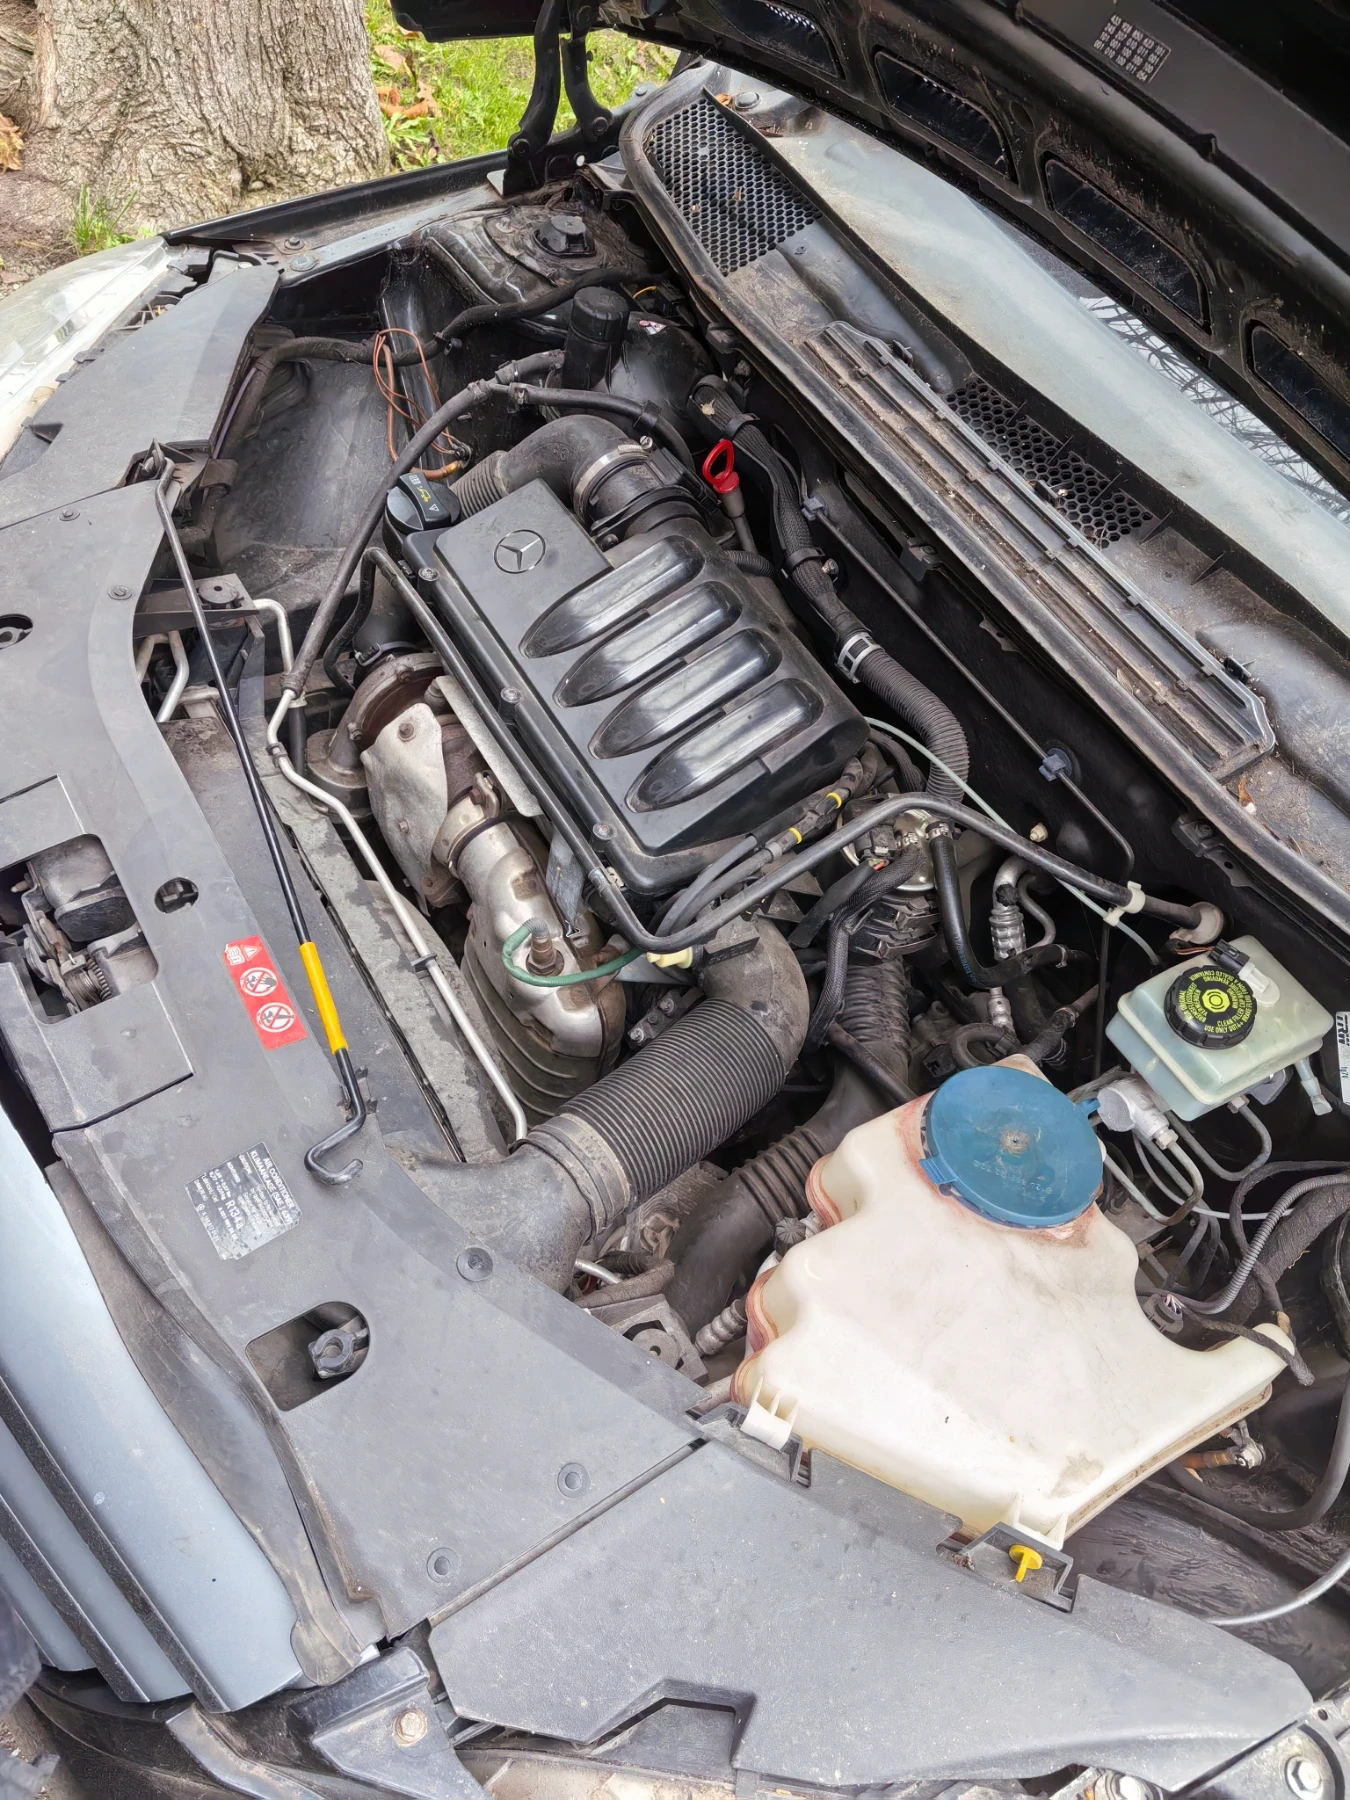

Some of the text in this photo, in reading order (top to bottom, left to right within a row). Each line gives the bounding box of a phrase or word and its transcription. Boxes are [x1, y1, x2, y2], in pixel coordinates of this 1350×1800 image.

[1337, 1014, 1350, 1046] TRW
[250, 1150, 276, 1192] KLIMAANLAGE
[263, 1158, 272, 1169] AIR
[268, 1168, 294, 1209] CONDITIONER
[225, 1200, 245, 1229] R134a
